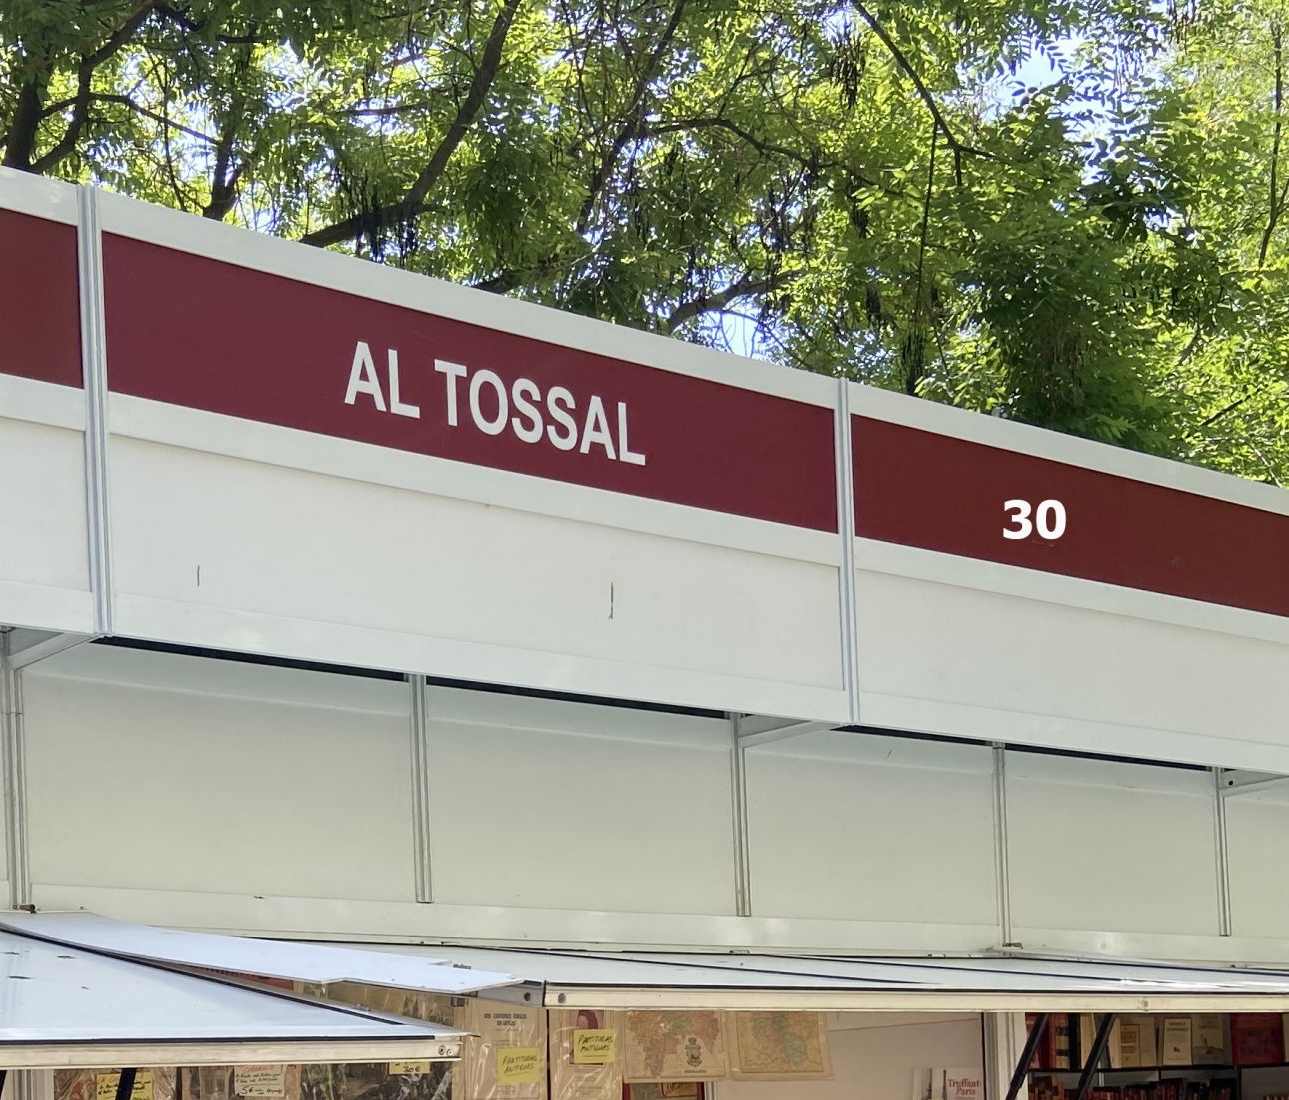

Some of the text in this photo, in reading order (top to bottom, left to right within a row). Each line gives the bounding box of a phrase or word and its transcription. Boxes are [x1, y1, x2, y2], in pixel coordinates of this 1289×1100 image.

[344, 340, 647, 466] AL TOSSAL
[1002, 498, 1067, 540] 30
